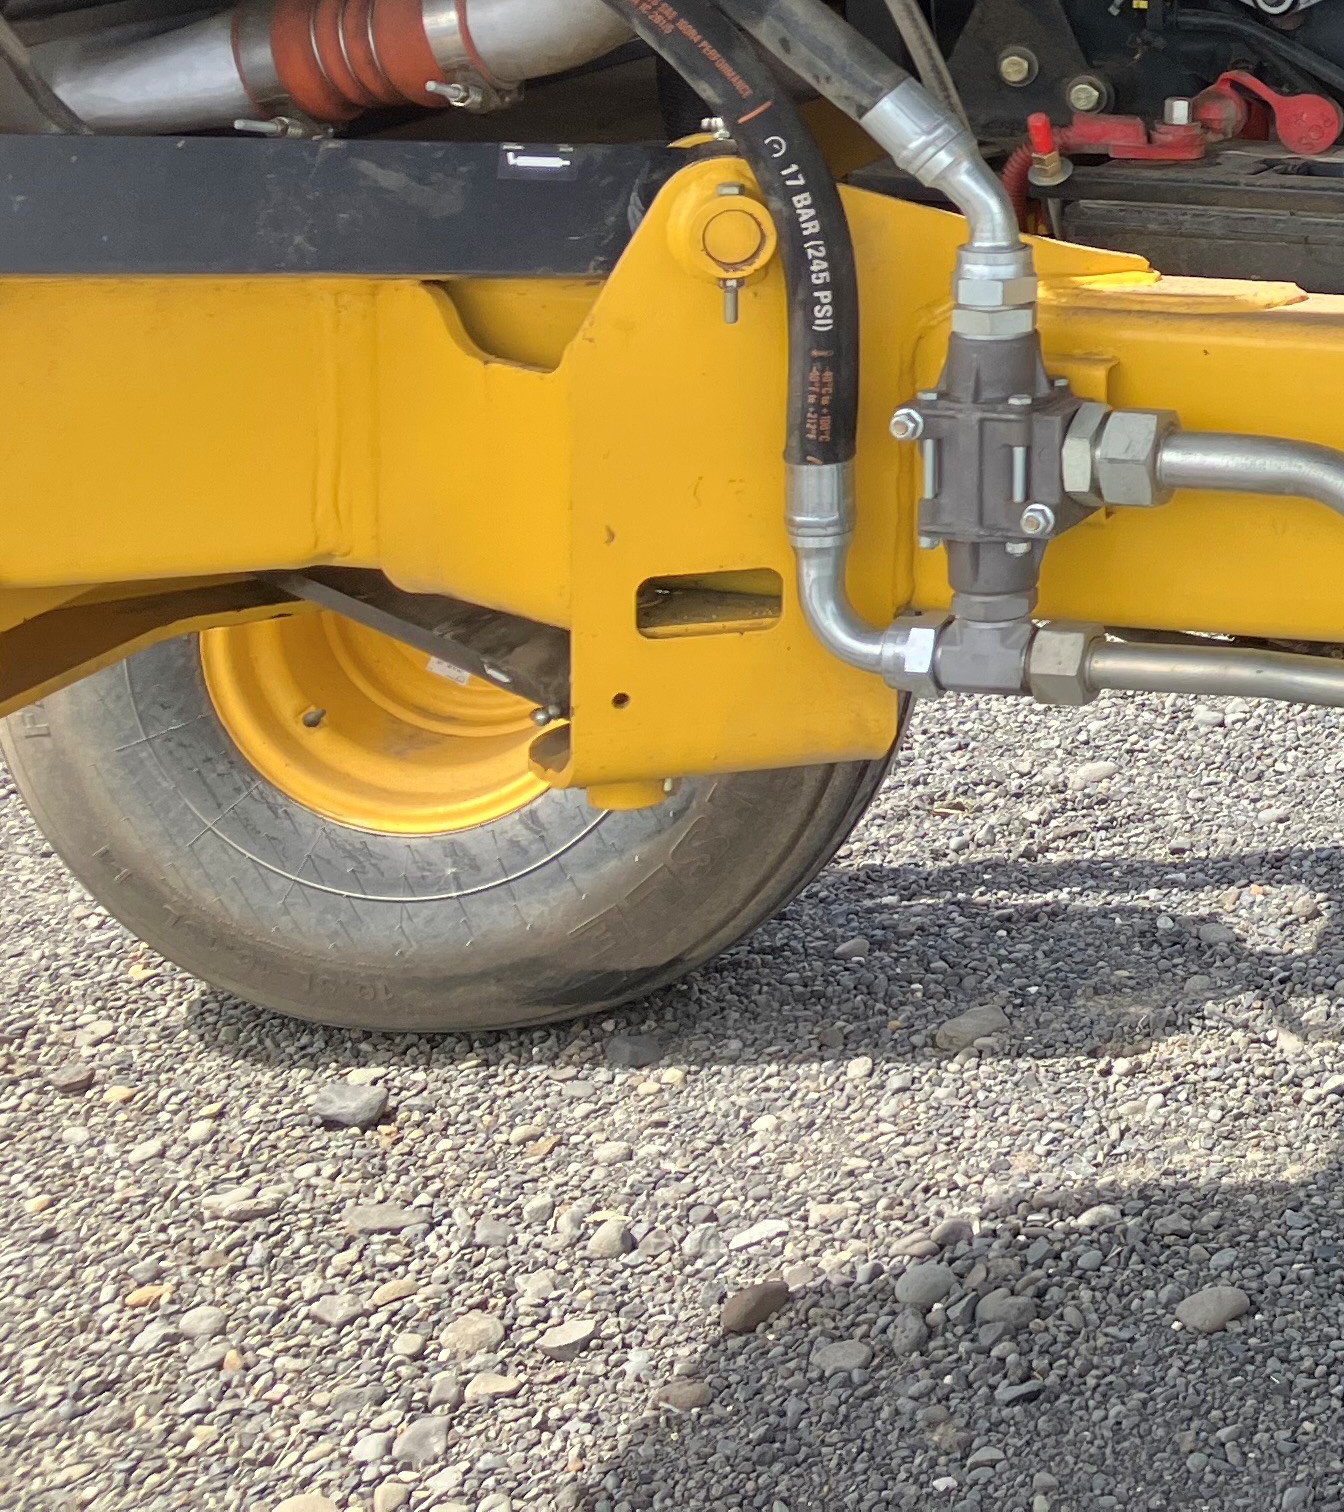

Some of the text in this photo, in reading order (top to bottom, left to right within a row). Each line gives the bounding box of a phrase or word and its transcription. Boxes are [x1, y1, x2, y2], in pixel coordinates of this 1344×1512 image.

[780, 163, 833, 332] 17 BAR (245 PSI)
